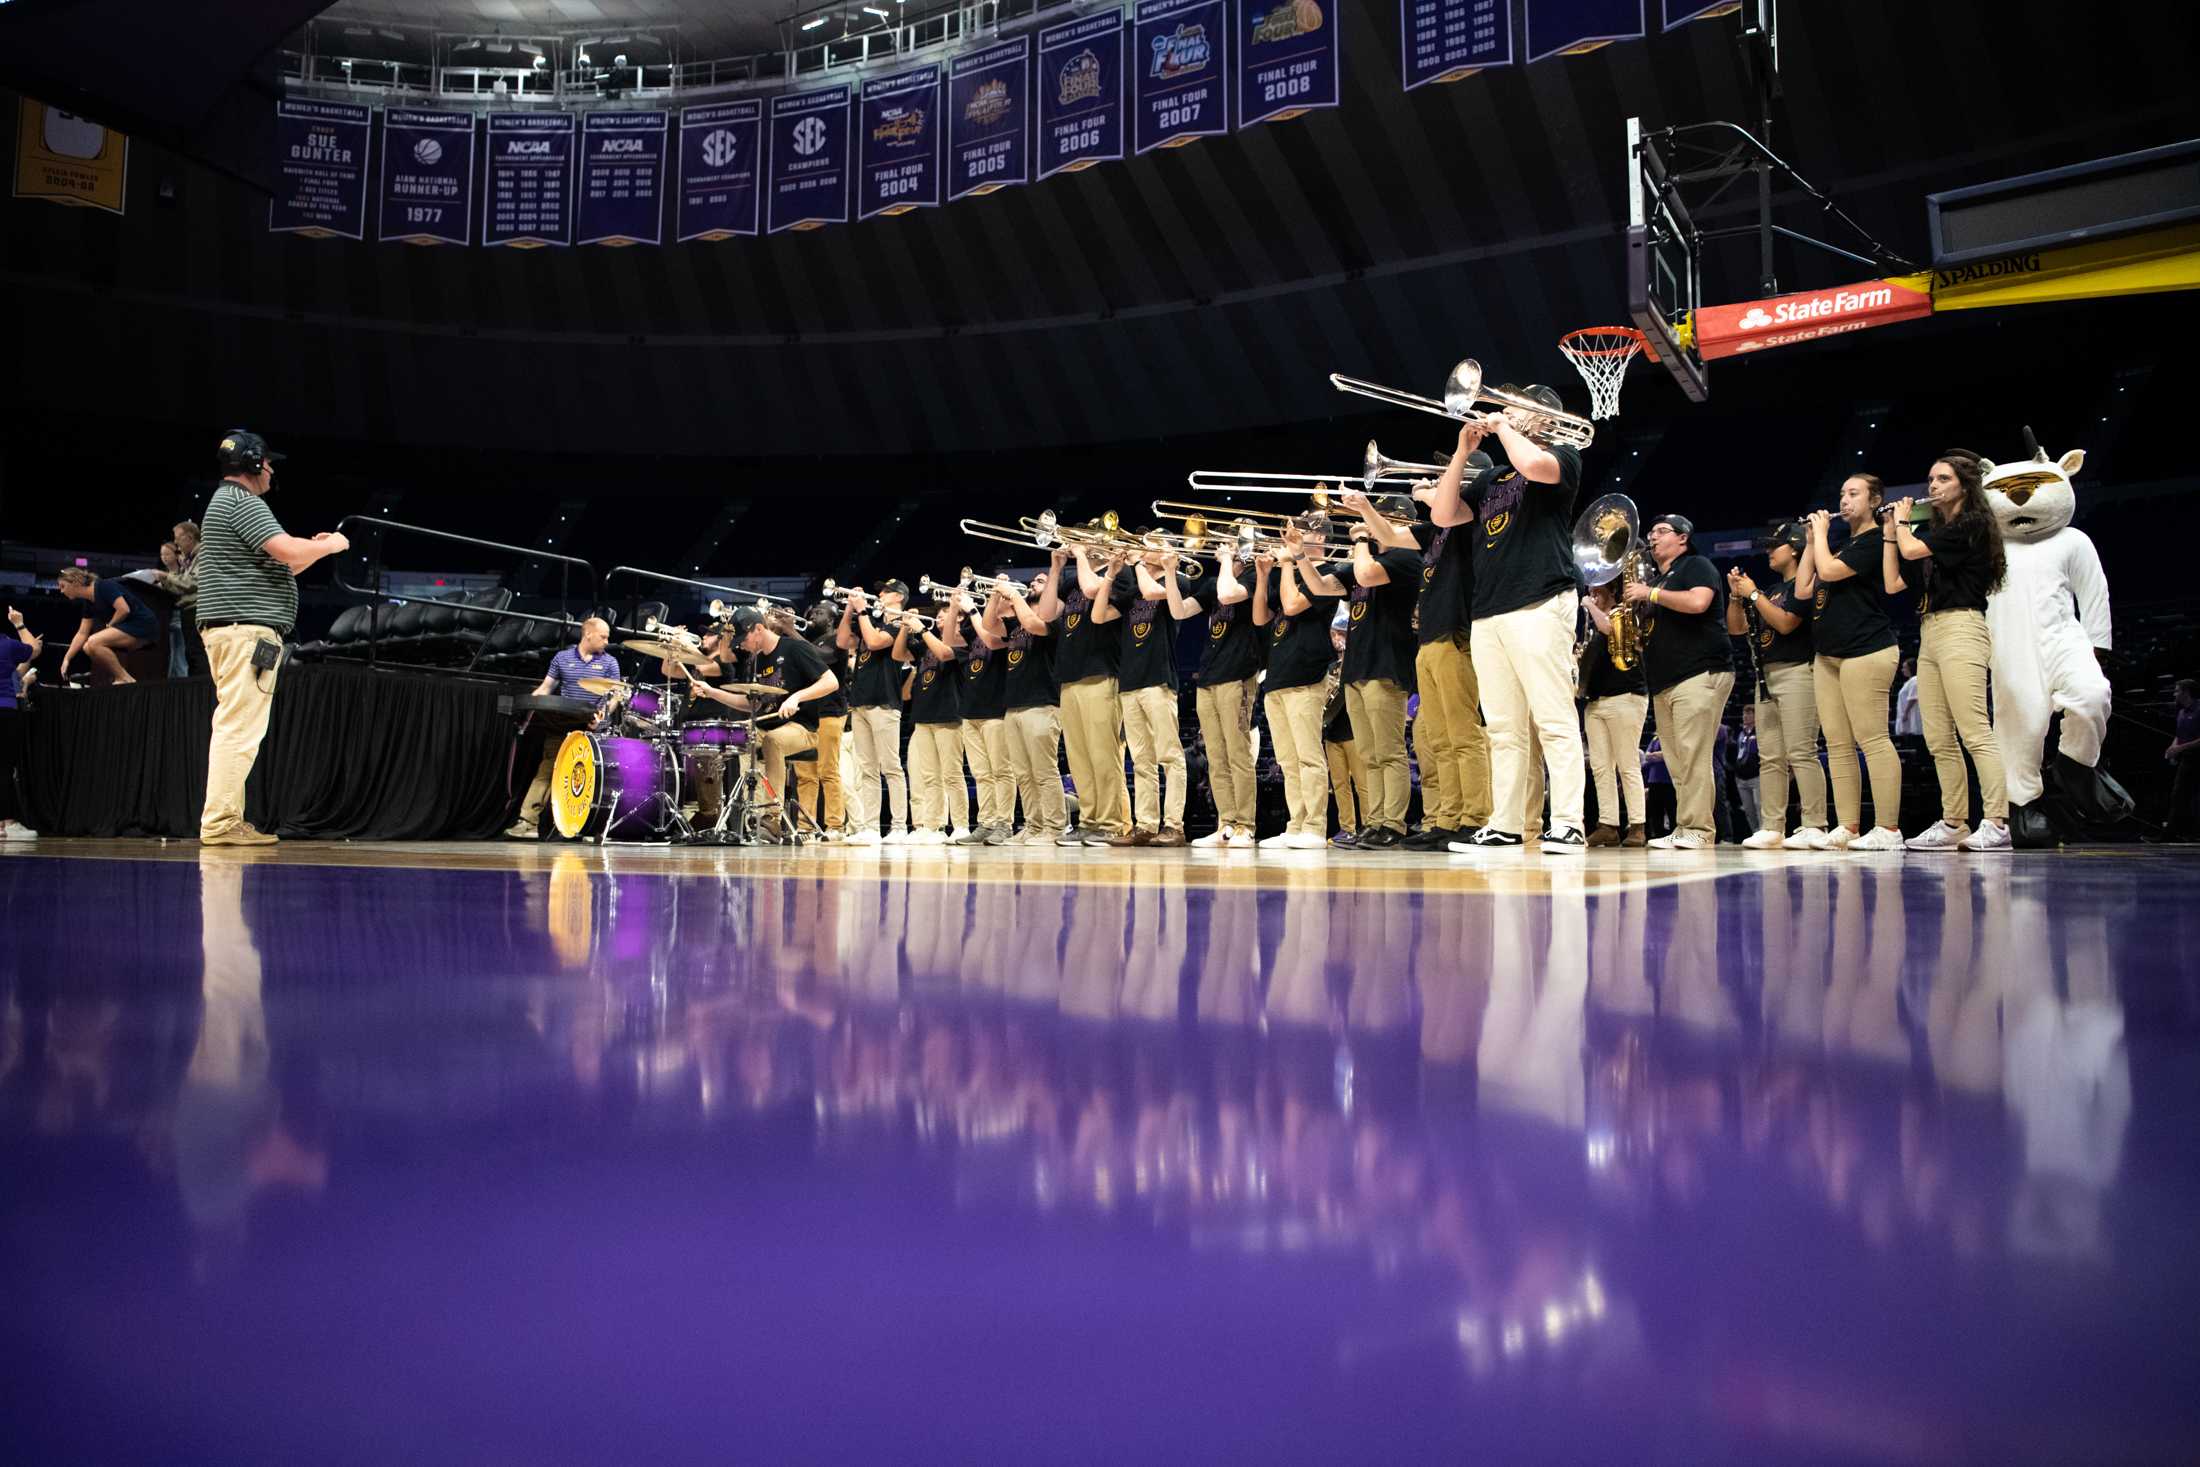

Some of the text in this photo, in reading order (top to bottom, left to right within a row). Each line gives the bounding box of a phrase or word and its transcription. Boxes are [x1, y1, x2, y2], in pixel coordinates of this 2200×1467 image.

[1257, 59, 1317, 83] FINAL FOUR
[1264, 75, 1311, 101] 2008
[1152, 88, 1208, 112] FINAL FOUR
[1054, 115, 1106, 137] FINAL FOUR
[1159, 103, 1201, 128] 2007
[307, 133, 337, 148] SUE
[601, 138, 643, 153] NCAA
[792, 116, 827, 156] SEC
[1059, 129, 1100, 153] 2006
[290, 144, 352, 162] GUNTER
[507, 140, 551, 154] NCAA
[702, 129, 737, 168] SEC
[963, 140, 1012, 161] FINAL FOUR
[787, 157, 830, 170] CHAMPIONS
[874, 163, 924, 182] FINAL FOUR
[968, 154, 1006, 177] 2005
[394, 183, 458, 195] RUNNER-UP
[418, 175, 458, 185] NATIONAL
[879, 176, 919, 197] 2004
[407, 206, 442, 222] 1977
[1940, 254, 2041, 288] SPALDING
